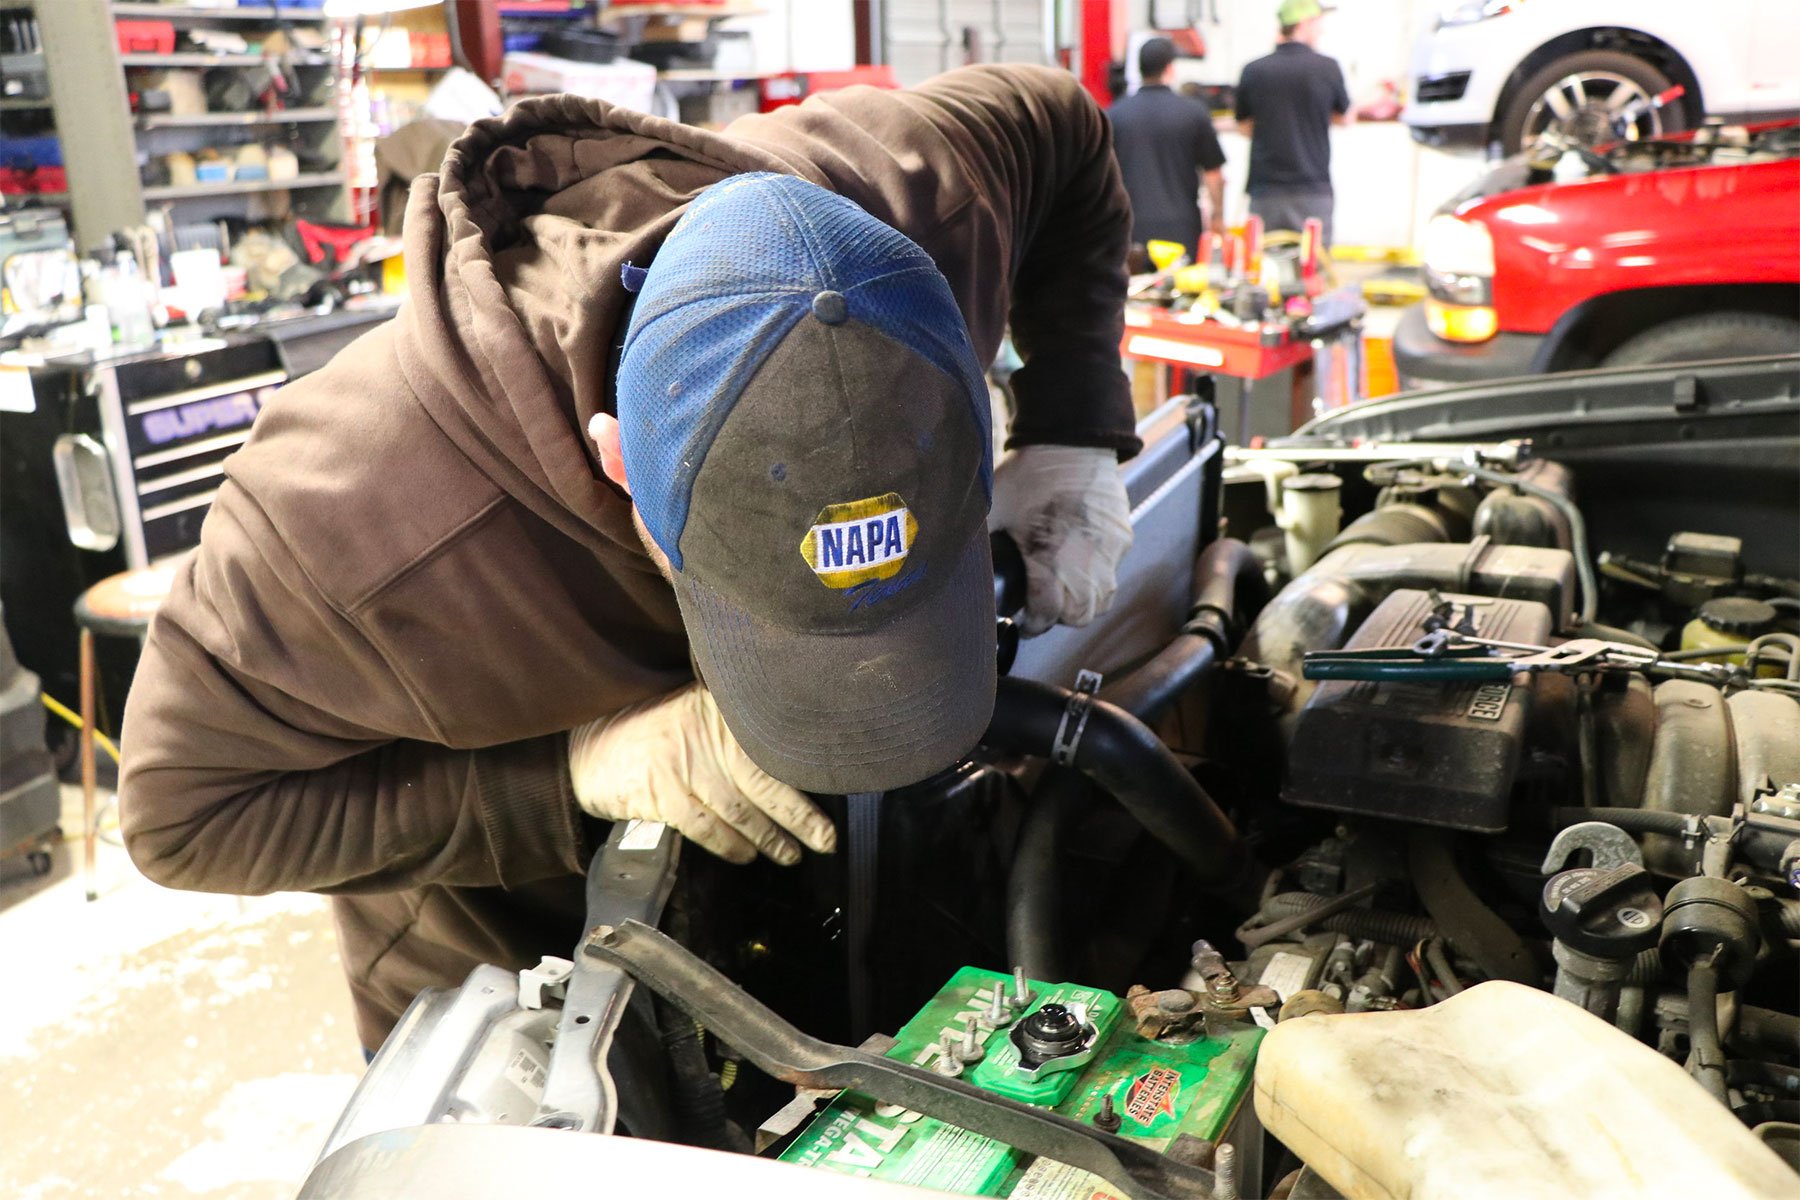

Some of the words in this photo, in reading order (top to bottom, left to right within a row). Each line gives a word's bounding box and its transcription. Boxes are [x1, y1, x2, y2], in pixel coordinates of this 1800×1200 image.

[821, 515, 902, 567] NAPA
[1128, 1069, 1163, 1116] BATTERIES
[1138, 1070, 1177, 1122] INTERSTATE
